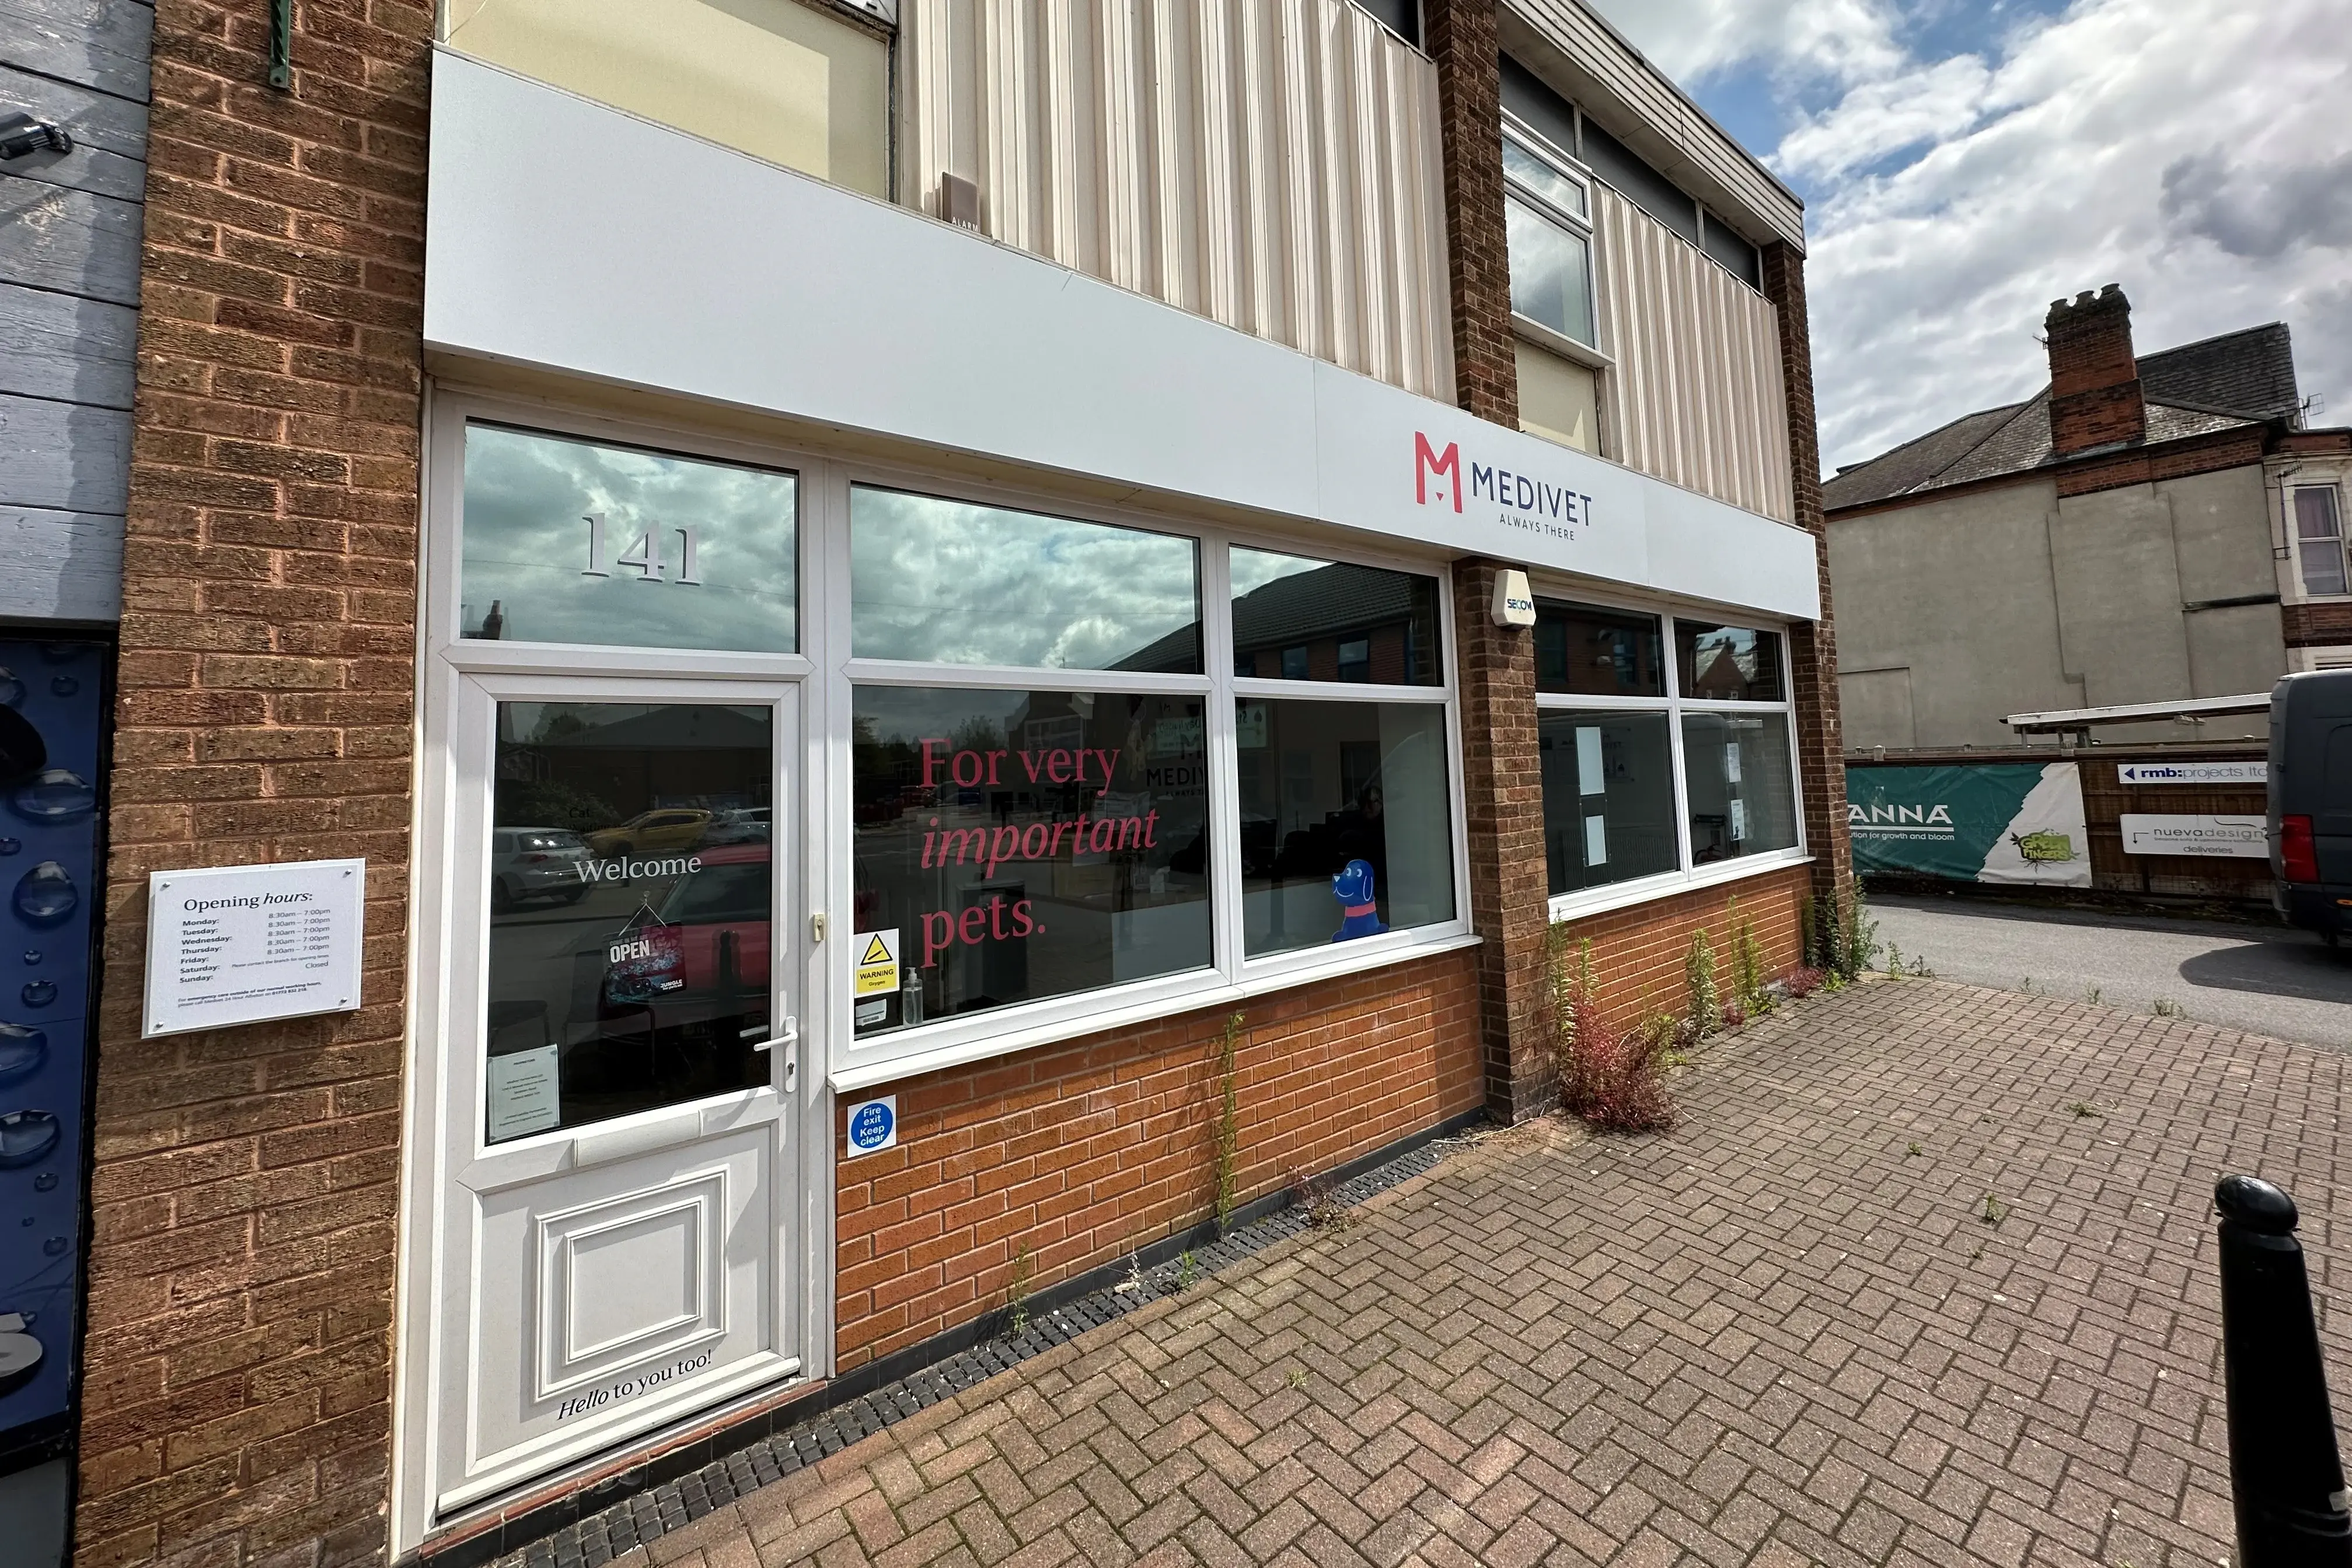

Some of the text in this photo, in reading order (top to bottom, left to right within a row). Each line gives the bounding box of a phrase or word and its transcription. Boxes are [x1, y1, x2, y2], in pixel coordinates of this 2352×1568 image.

[952, 216, 978, 233] ALARM
[1472, 461, 1592, 526] MEDIVET
[1499, 513, 1575, 541] ALWAYS THERE
[581, 512, 704, 587] 141
[1507, 598, 1533, 611] SECOM
[918, 738, 1121, 797] For very
[1146, 767, 1204, 787] MEDI
[1847, 804, 1953, 825] ANNA
[920, 808, 1160, 879] important
[1869, 832, 1880, 840] for
[1882, 832, 1908, 840] growth
[2183, 846, 2234, 854] deliveries
[572, 856, 702, 883] Welcome
[184, 892, 313, 913] Opening hours:
[181, 936, 233, 945] Wednesday:
[919, 895, 1046, 969] pets.
[181, 946, 222, 955] Thursday:
[610, 940, 650, 963] OPEN
[179, 961, 329, 983] Sunday: Closed
[180, 965, 221, 974] Saturday:
[859, 968, 894, 980] WARNING
[863, 1107, 882, 1117] Fire
[863, 1114, 882, 1126] exit
[860, 1125, 885, 1137] Keep
[860, 1133, 885, 1146] clear
[556, 1349, 712, 1421] Hello to you too!
